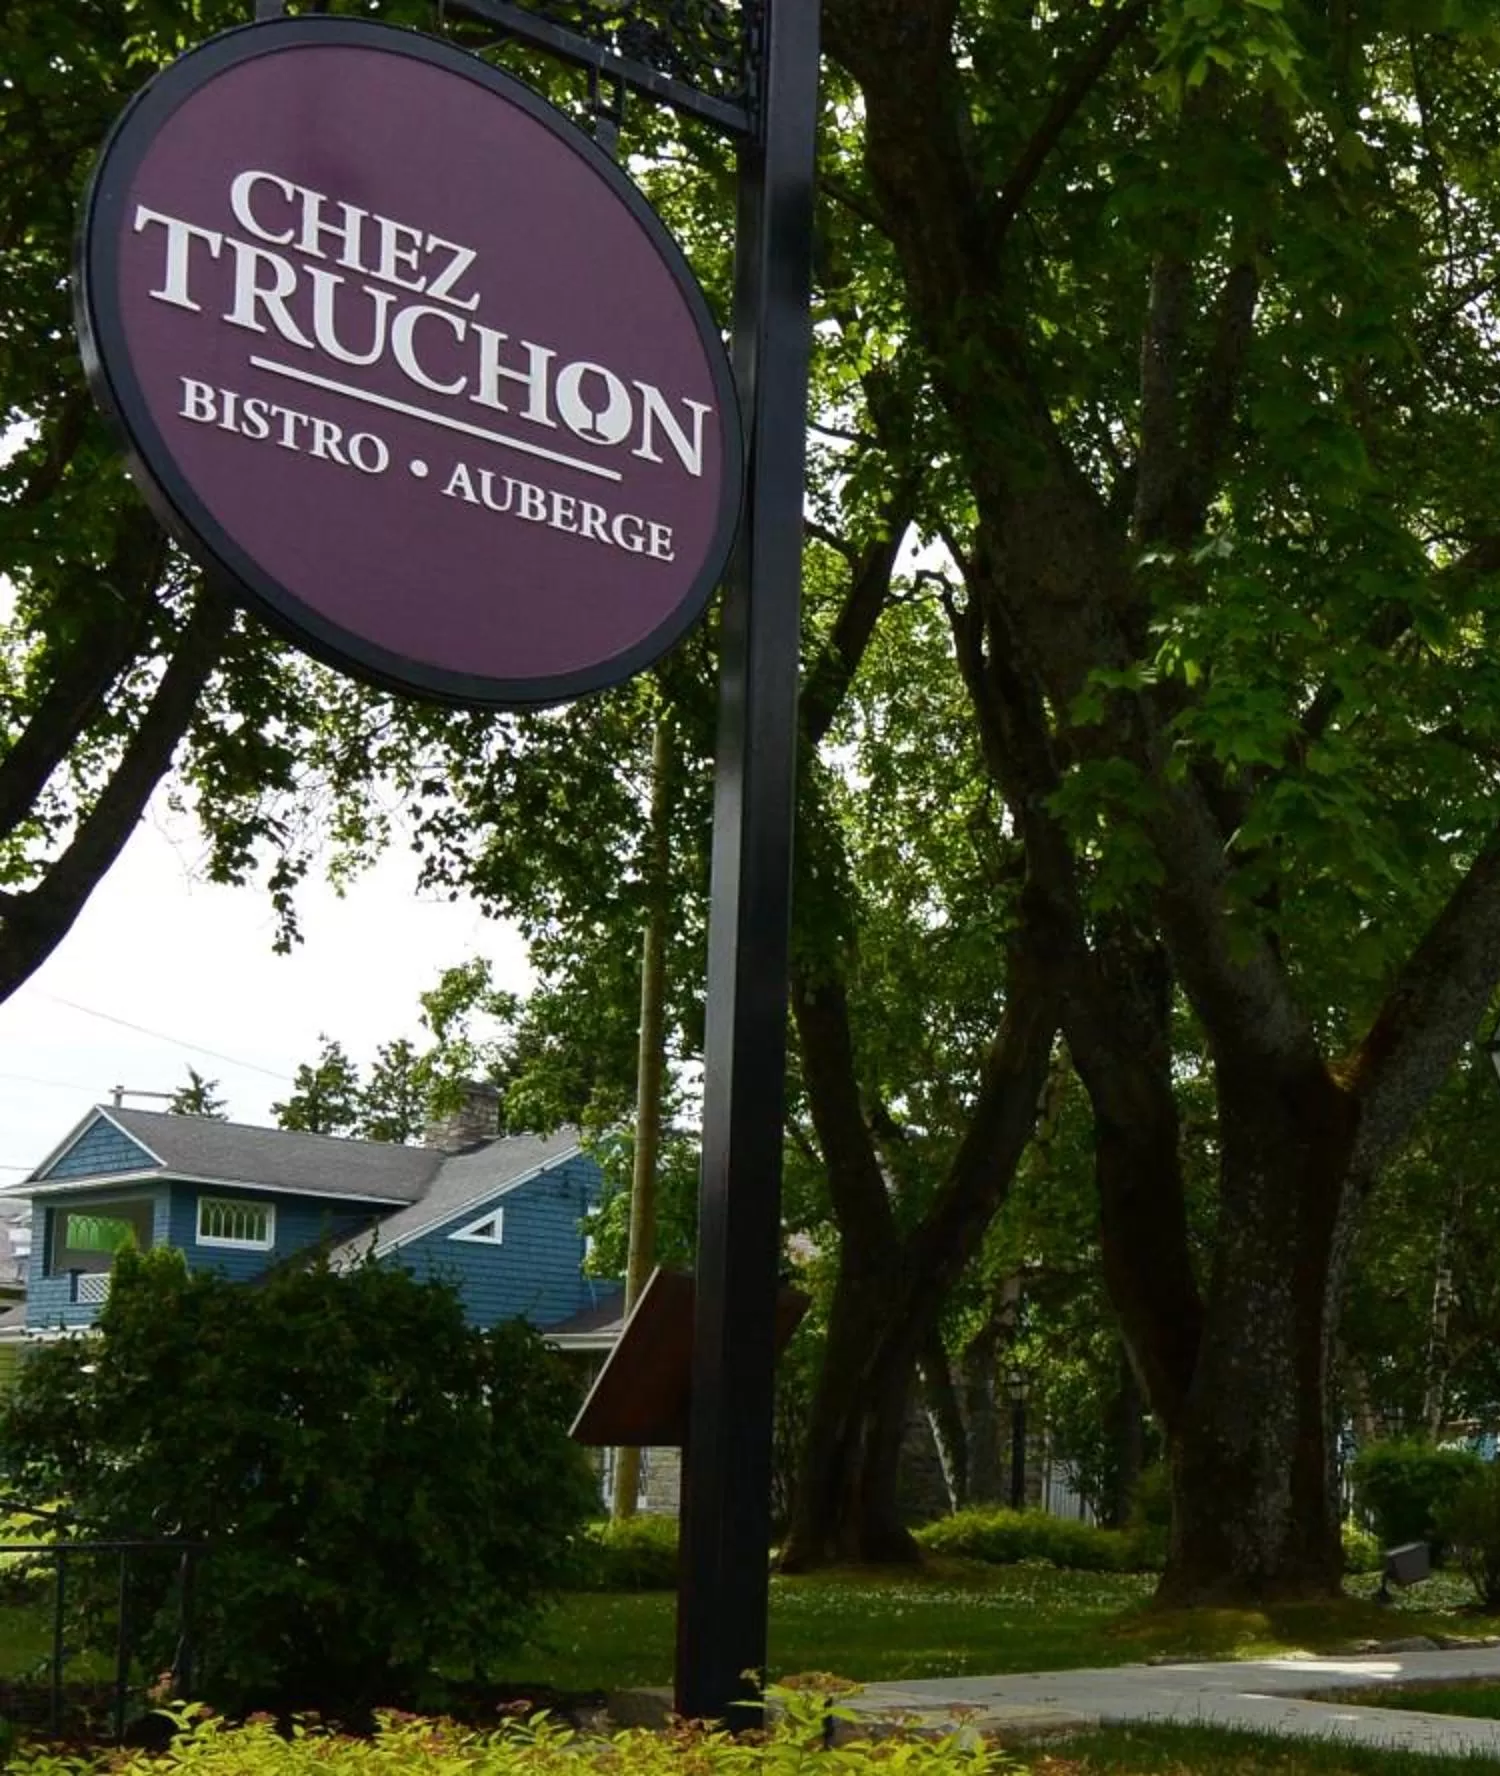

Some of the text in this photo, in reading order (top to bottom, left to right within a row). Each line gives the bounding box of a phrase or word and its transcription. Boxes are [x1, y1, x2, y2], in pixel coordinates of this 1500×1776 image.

[231, 171, 480, 310] CHEZ
[135, 205, 711, 476] TRUCHON
[180, 378, 675, 561] BISTRO AUBERGE
